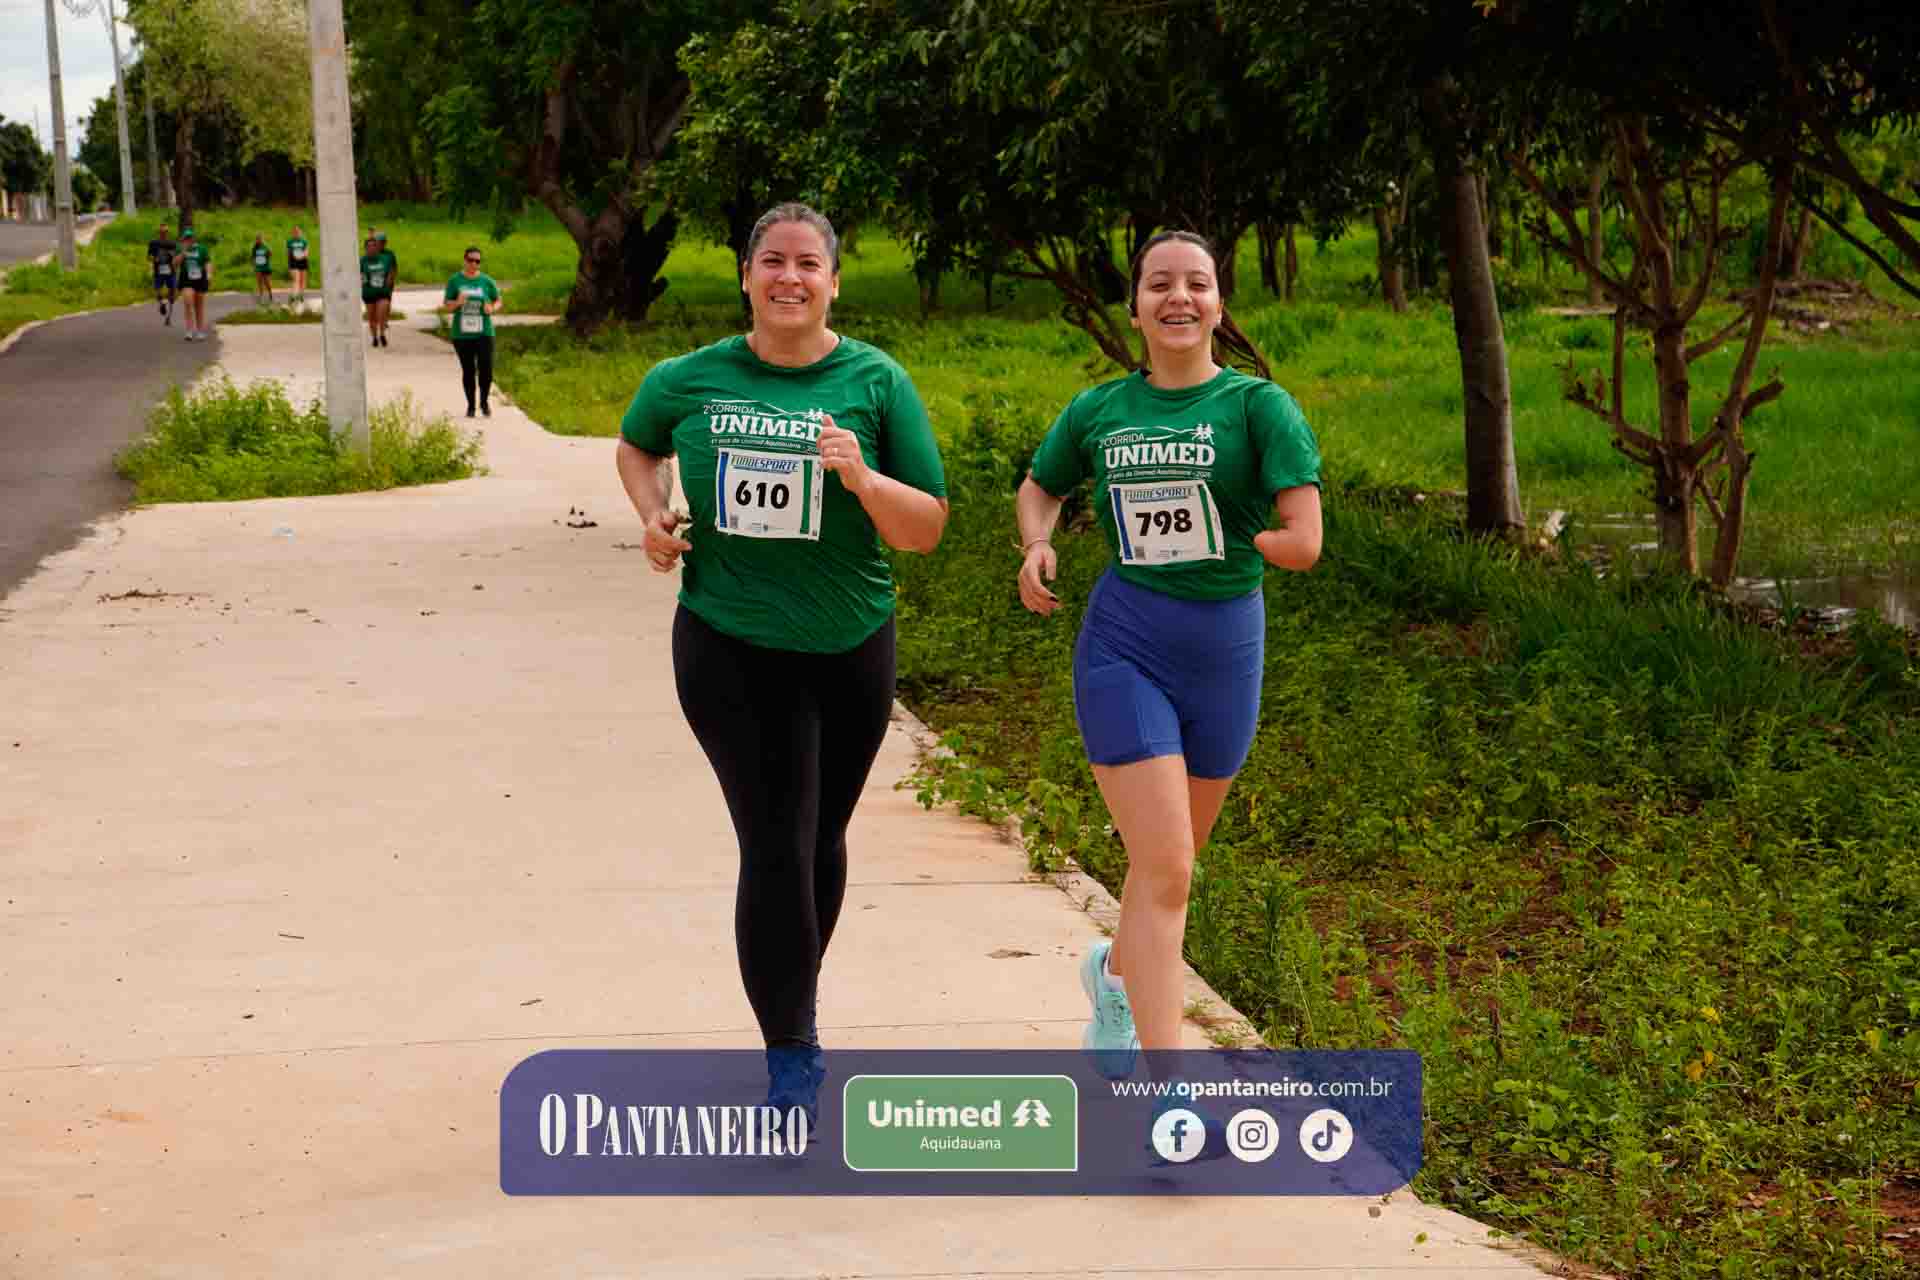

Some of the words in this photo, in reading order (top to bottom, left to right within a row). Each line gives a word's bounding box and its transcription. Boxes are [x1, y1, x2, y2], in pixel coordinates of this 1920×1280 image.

[711, 404, 756, 415] CORRIDA
[1104, 433, 1145, 447] CORRIDA
[1104, 442, 1216, 469] UNIMED
[735, 480, 790, 509] 610
[1136, 508, 1193, 537] 798
